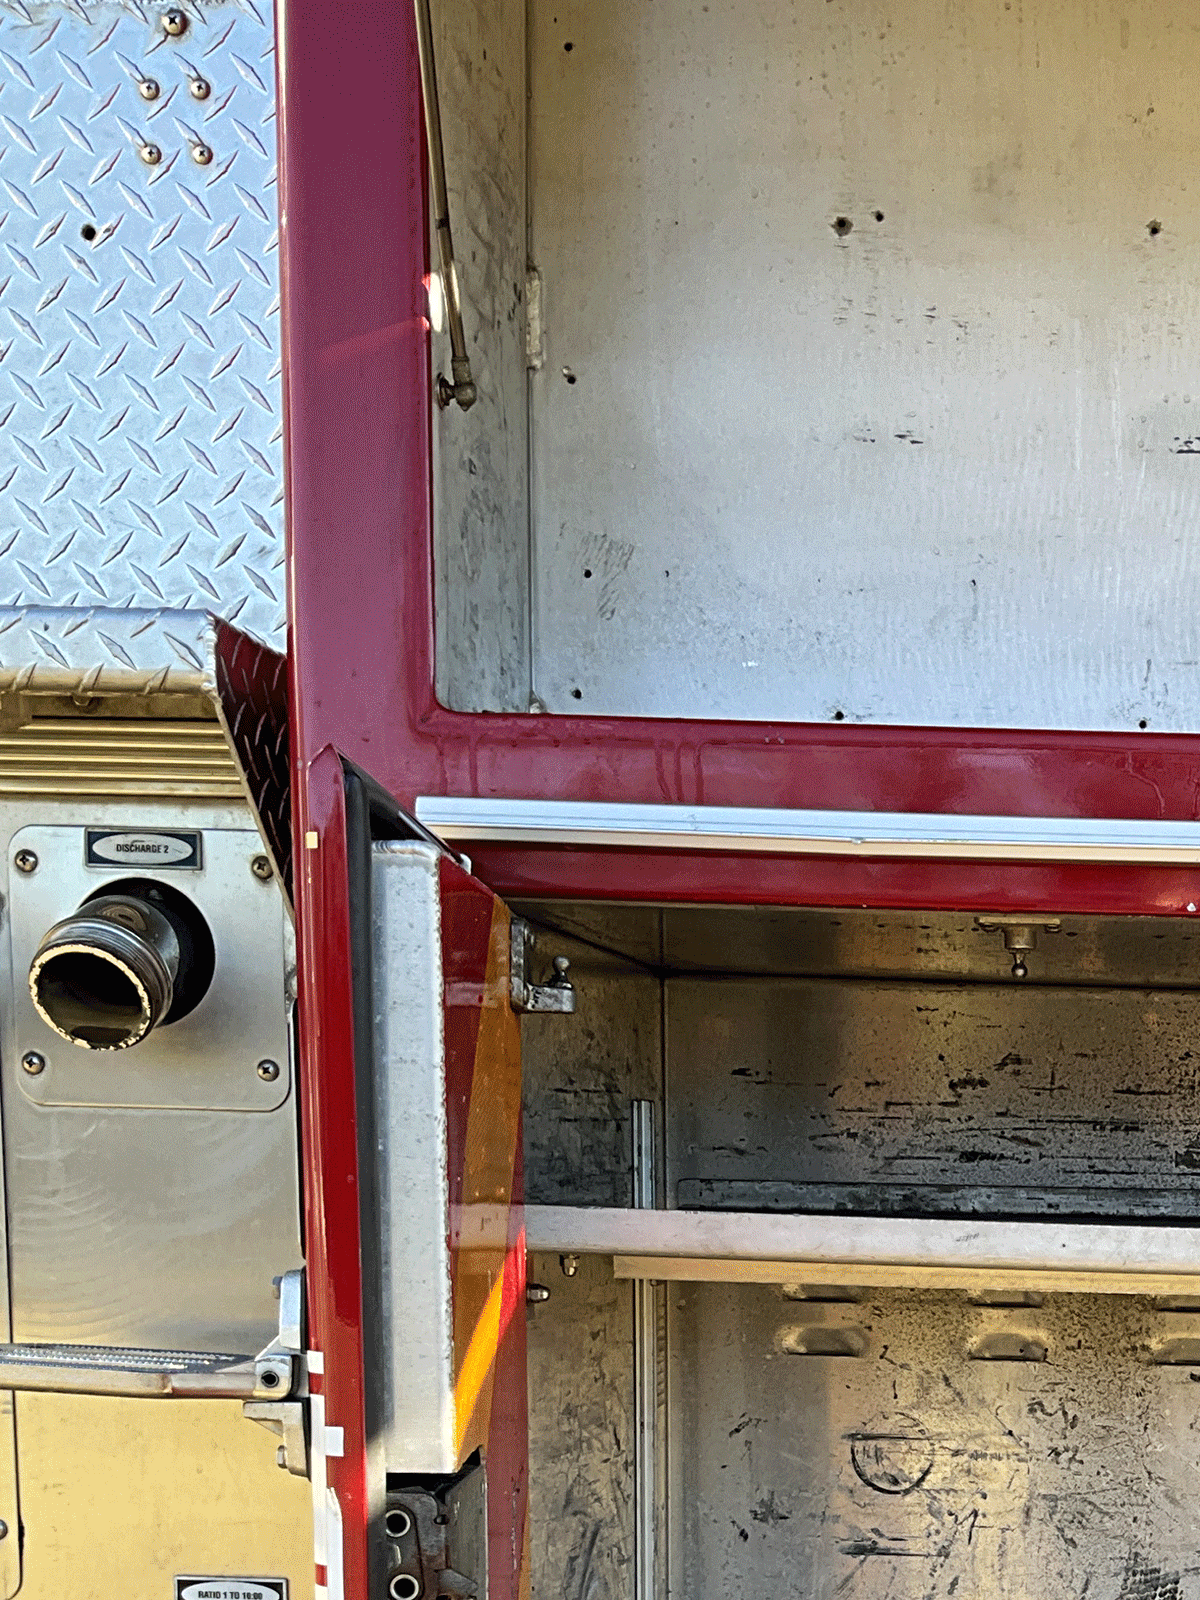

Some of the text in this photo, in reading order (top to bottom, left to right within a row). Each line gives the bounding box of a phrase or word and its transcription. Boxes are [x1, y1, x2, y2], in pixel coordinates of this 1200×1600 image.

[116, 843, 169, 853] DISCHARGE 2
[198, 1591, 221, 1599] RATIO
[229, 1592, 240, 1600] TO
